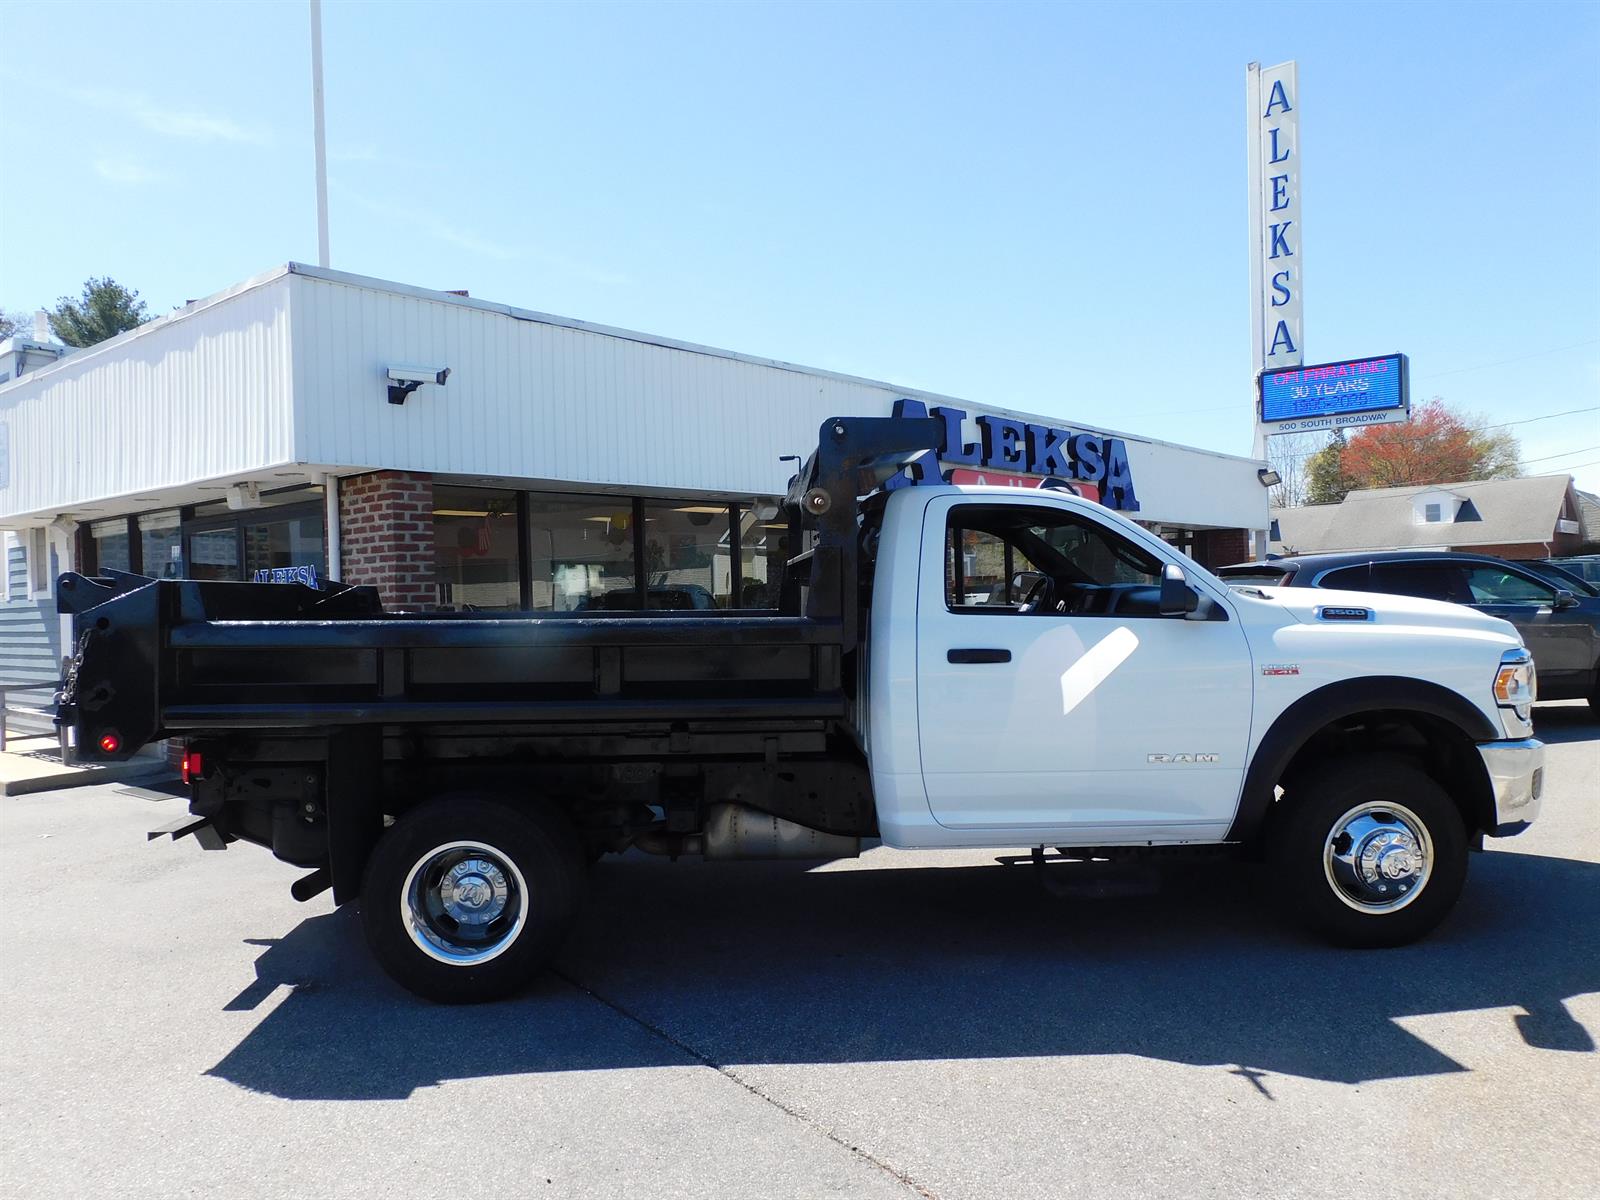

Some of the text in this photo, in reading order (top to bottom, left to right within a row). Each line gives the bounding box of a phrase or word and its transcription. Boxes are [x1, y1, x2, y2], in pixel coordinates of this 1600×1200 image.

[1263, 79, 1297, 356] ALEKSA
[1290, 378, 1369, 399] 30 YEARS
[1279, 413, 1388, 431] 500 SOUTH BROADWAY
[885, 398, 1140, 512] ALEKSA
[1147, 752, 1219, 764] RAM
